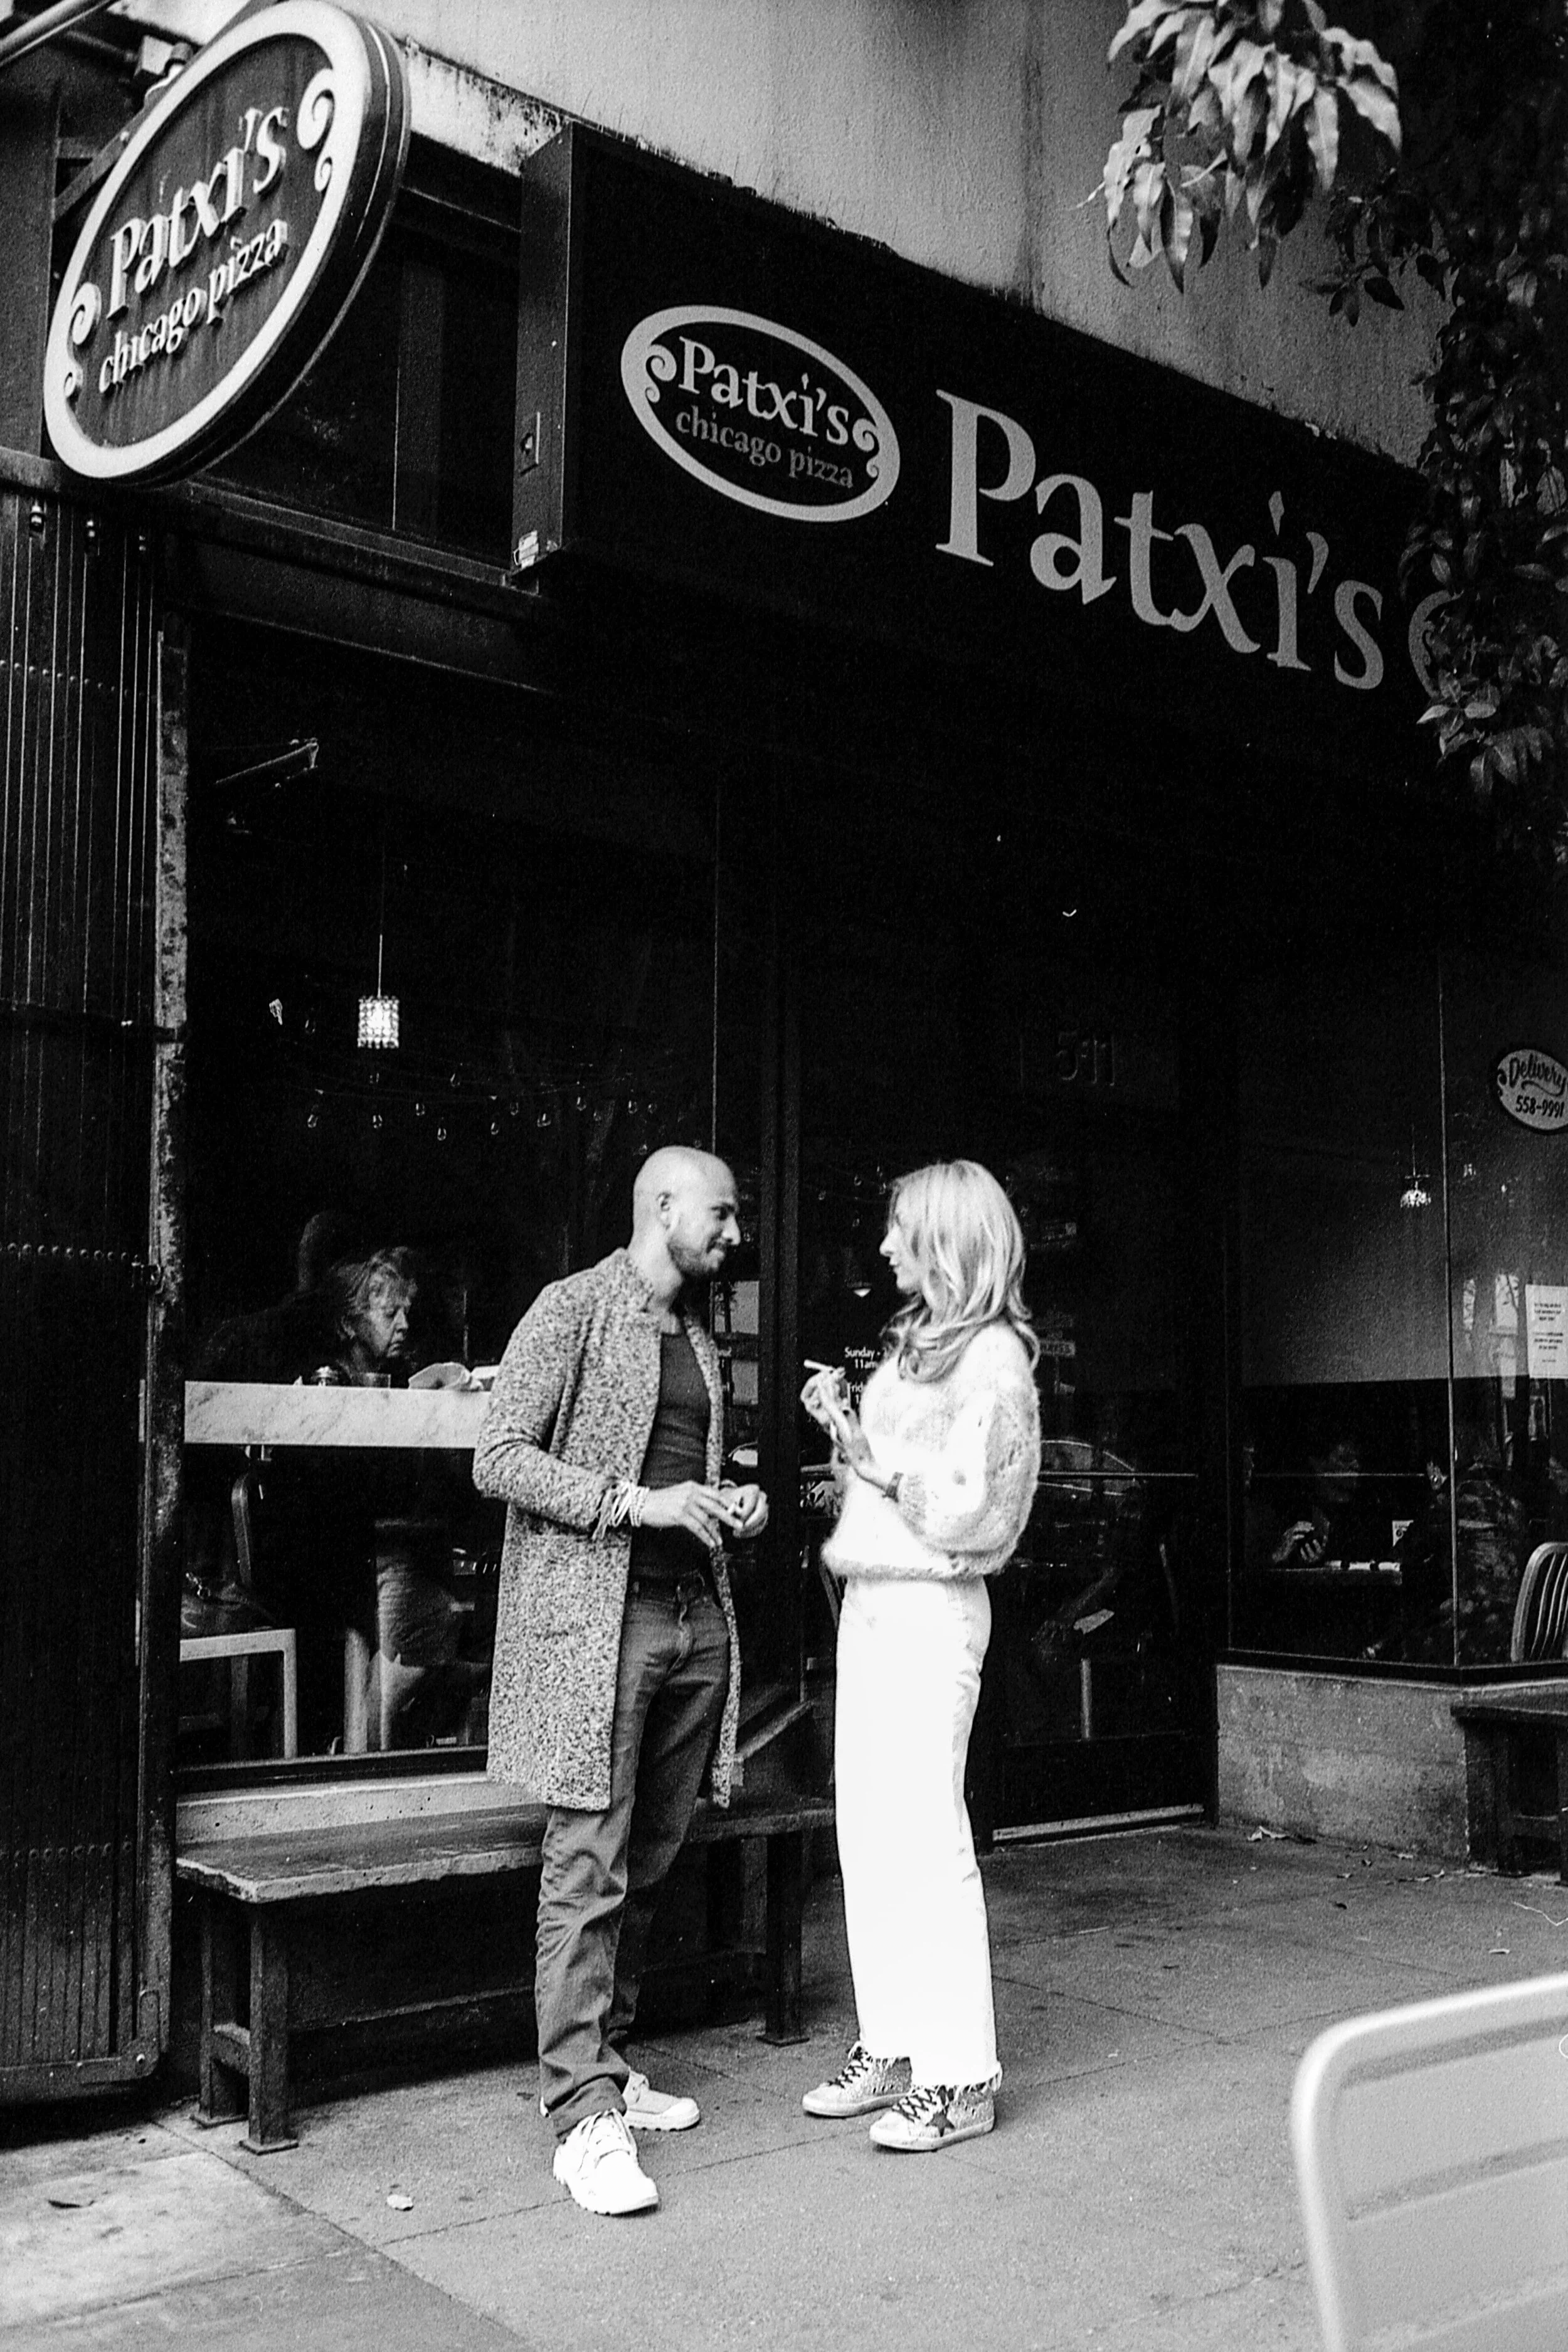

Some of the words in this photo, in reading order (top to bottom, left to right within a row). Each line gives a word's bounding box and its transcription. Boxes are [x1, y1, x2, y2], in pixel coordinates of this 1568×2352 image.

[107, 107, 289, 319] Patxi's
[99, 287, 206, 393] chicago
[207, 219, 288, 324] pizza
[679, 336, 849, 445] Patxi's
[675, 405, 781, 466] chicago
[789, 446, 854, 488] pizza
[935, 389, 1384, 689] Patxi's
[1509, 1054, 1567, 1097] Delivery
[1515, 1095, 1564, 1118] 558-9991
[844, 1347, 875, 1360] Sunday
